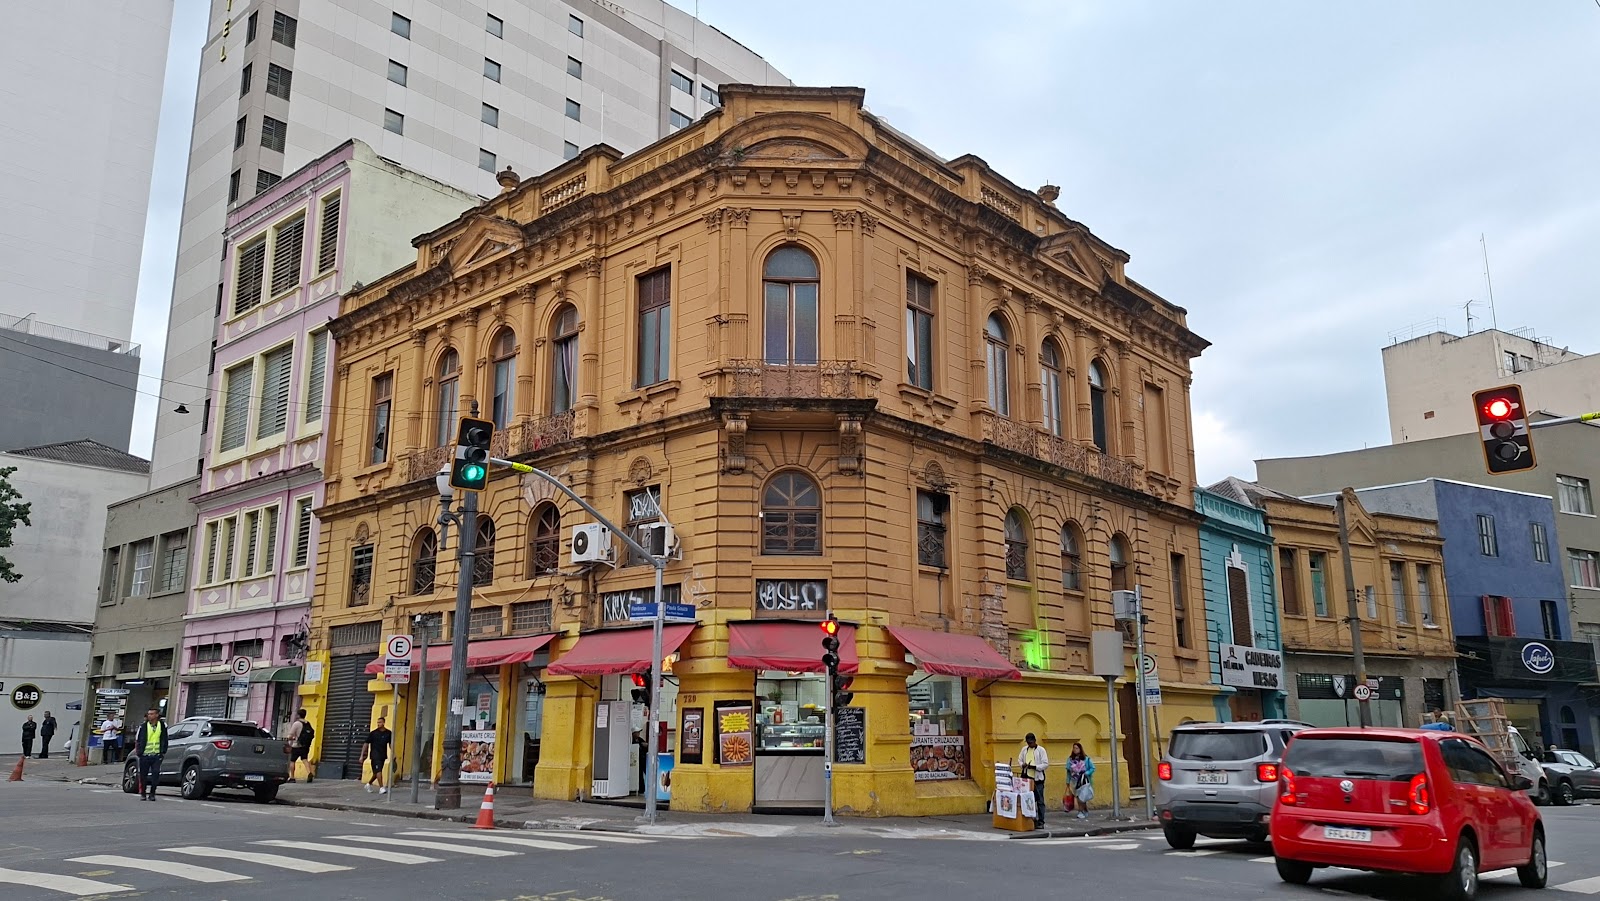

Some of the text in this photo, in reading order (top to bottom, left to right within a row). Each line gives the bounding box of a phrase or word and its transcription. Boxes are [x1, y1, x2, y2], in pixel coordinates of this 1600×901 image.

[395, 641, 403, 653] E
[1245, 651, 1281, 668] CADEIRAS
[237, 660, 245, 671] E
[1252, 671, 1278, 688] MESAS
[15, 691, 38, 700] B&B
[1356, 687, 1369, 696] 40
[683, 695, 697, 703] 720
